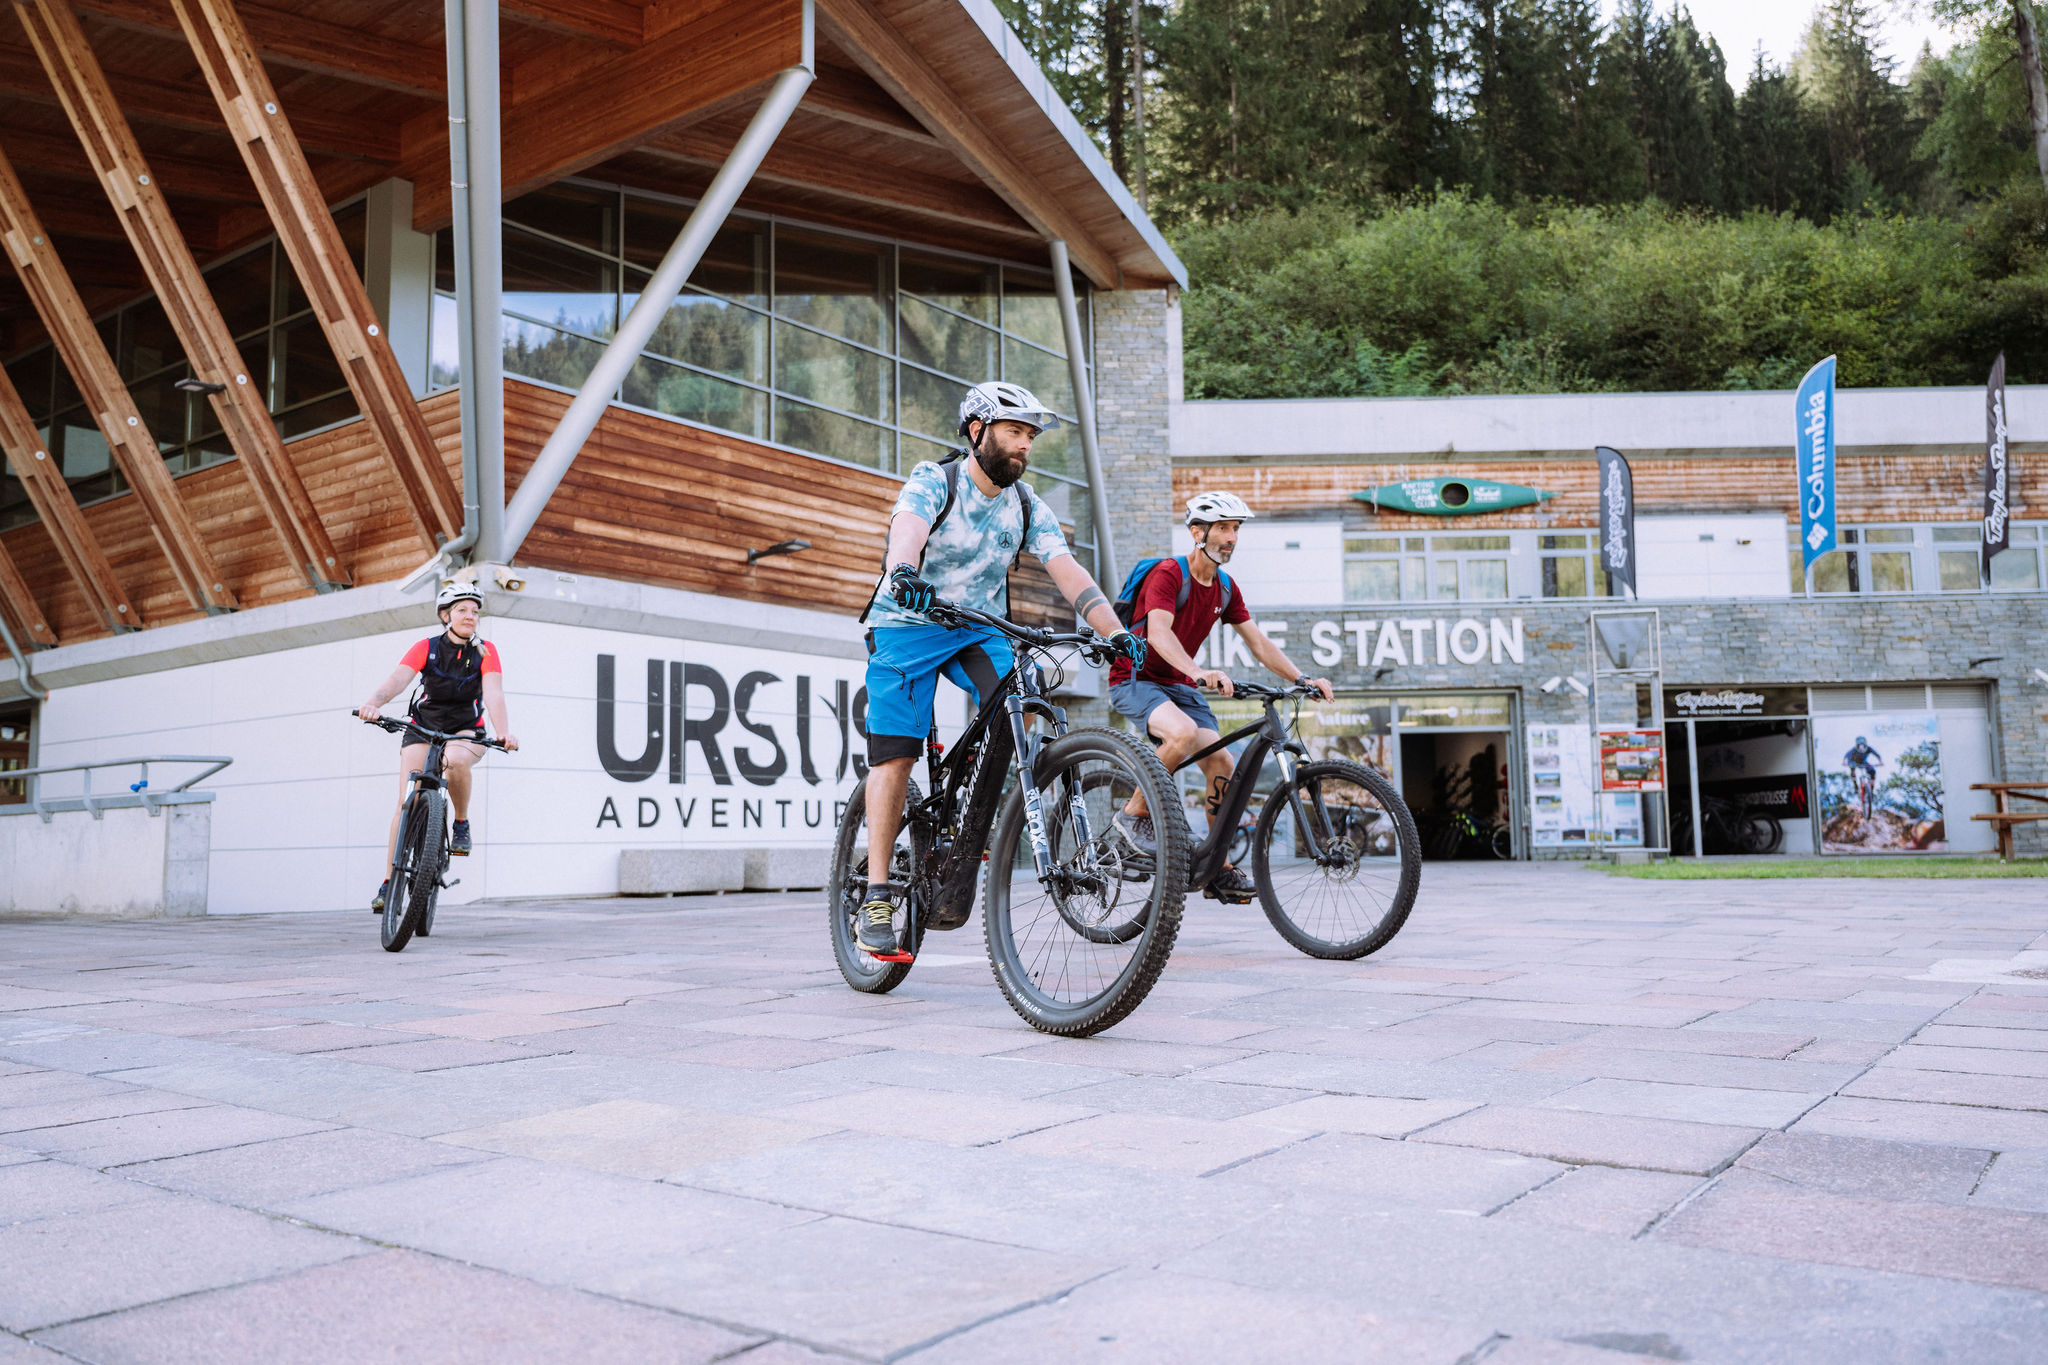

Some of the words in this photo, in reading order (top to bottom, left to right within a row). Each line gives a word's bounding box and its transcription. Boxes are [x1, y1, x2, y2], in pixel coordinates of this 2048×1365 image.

[1804, 389, 1826, 521] Columbia
[1311, 617, 1524, 668] STATION
[1026, 808, 1048, 847] FOX
[1015, 992, 1043, 1016] BUTCHER
